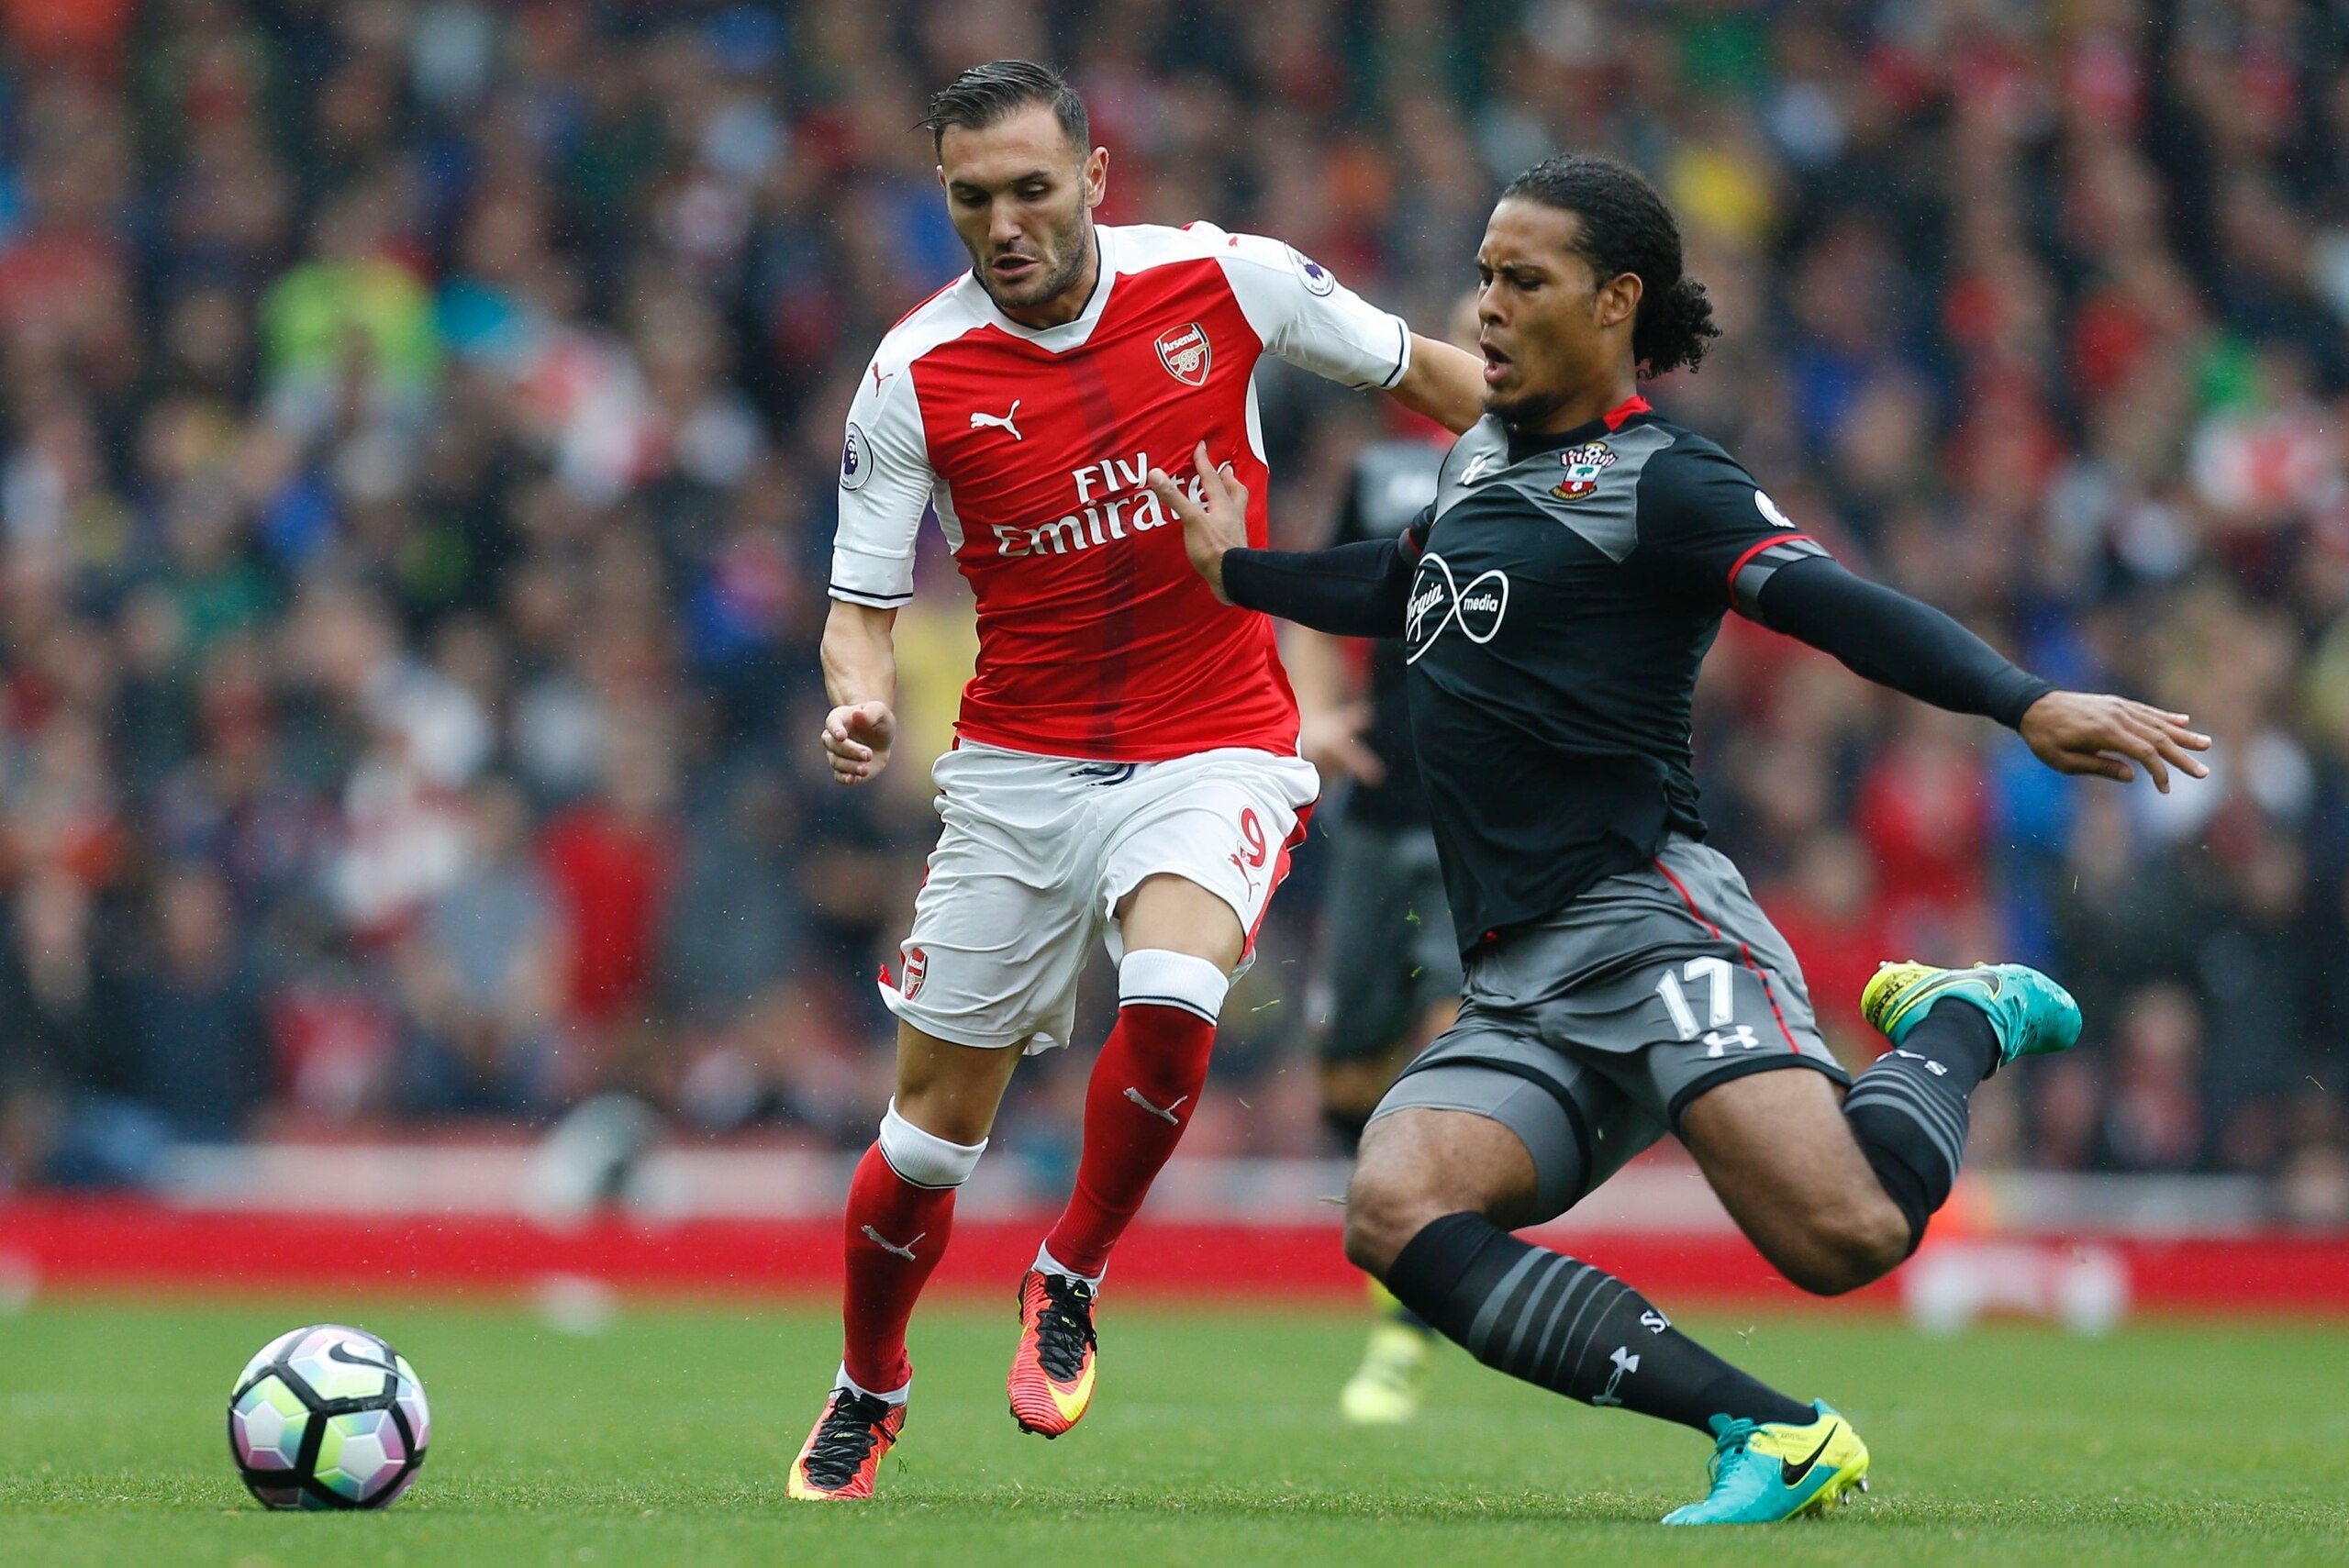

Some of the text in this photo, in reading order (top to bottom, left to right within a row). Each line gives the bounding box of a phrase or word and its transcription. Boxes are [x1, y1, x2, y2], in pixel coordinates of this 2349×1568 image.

[1163, 329, 1199, 354] Arsenal
[1071, 451, 1149, 505] Fly
[1463, 593, 1499, 612] media
[1238, 806, 1267, 869] 9
[1654, 955, 1734, 1042] 17
